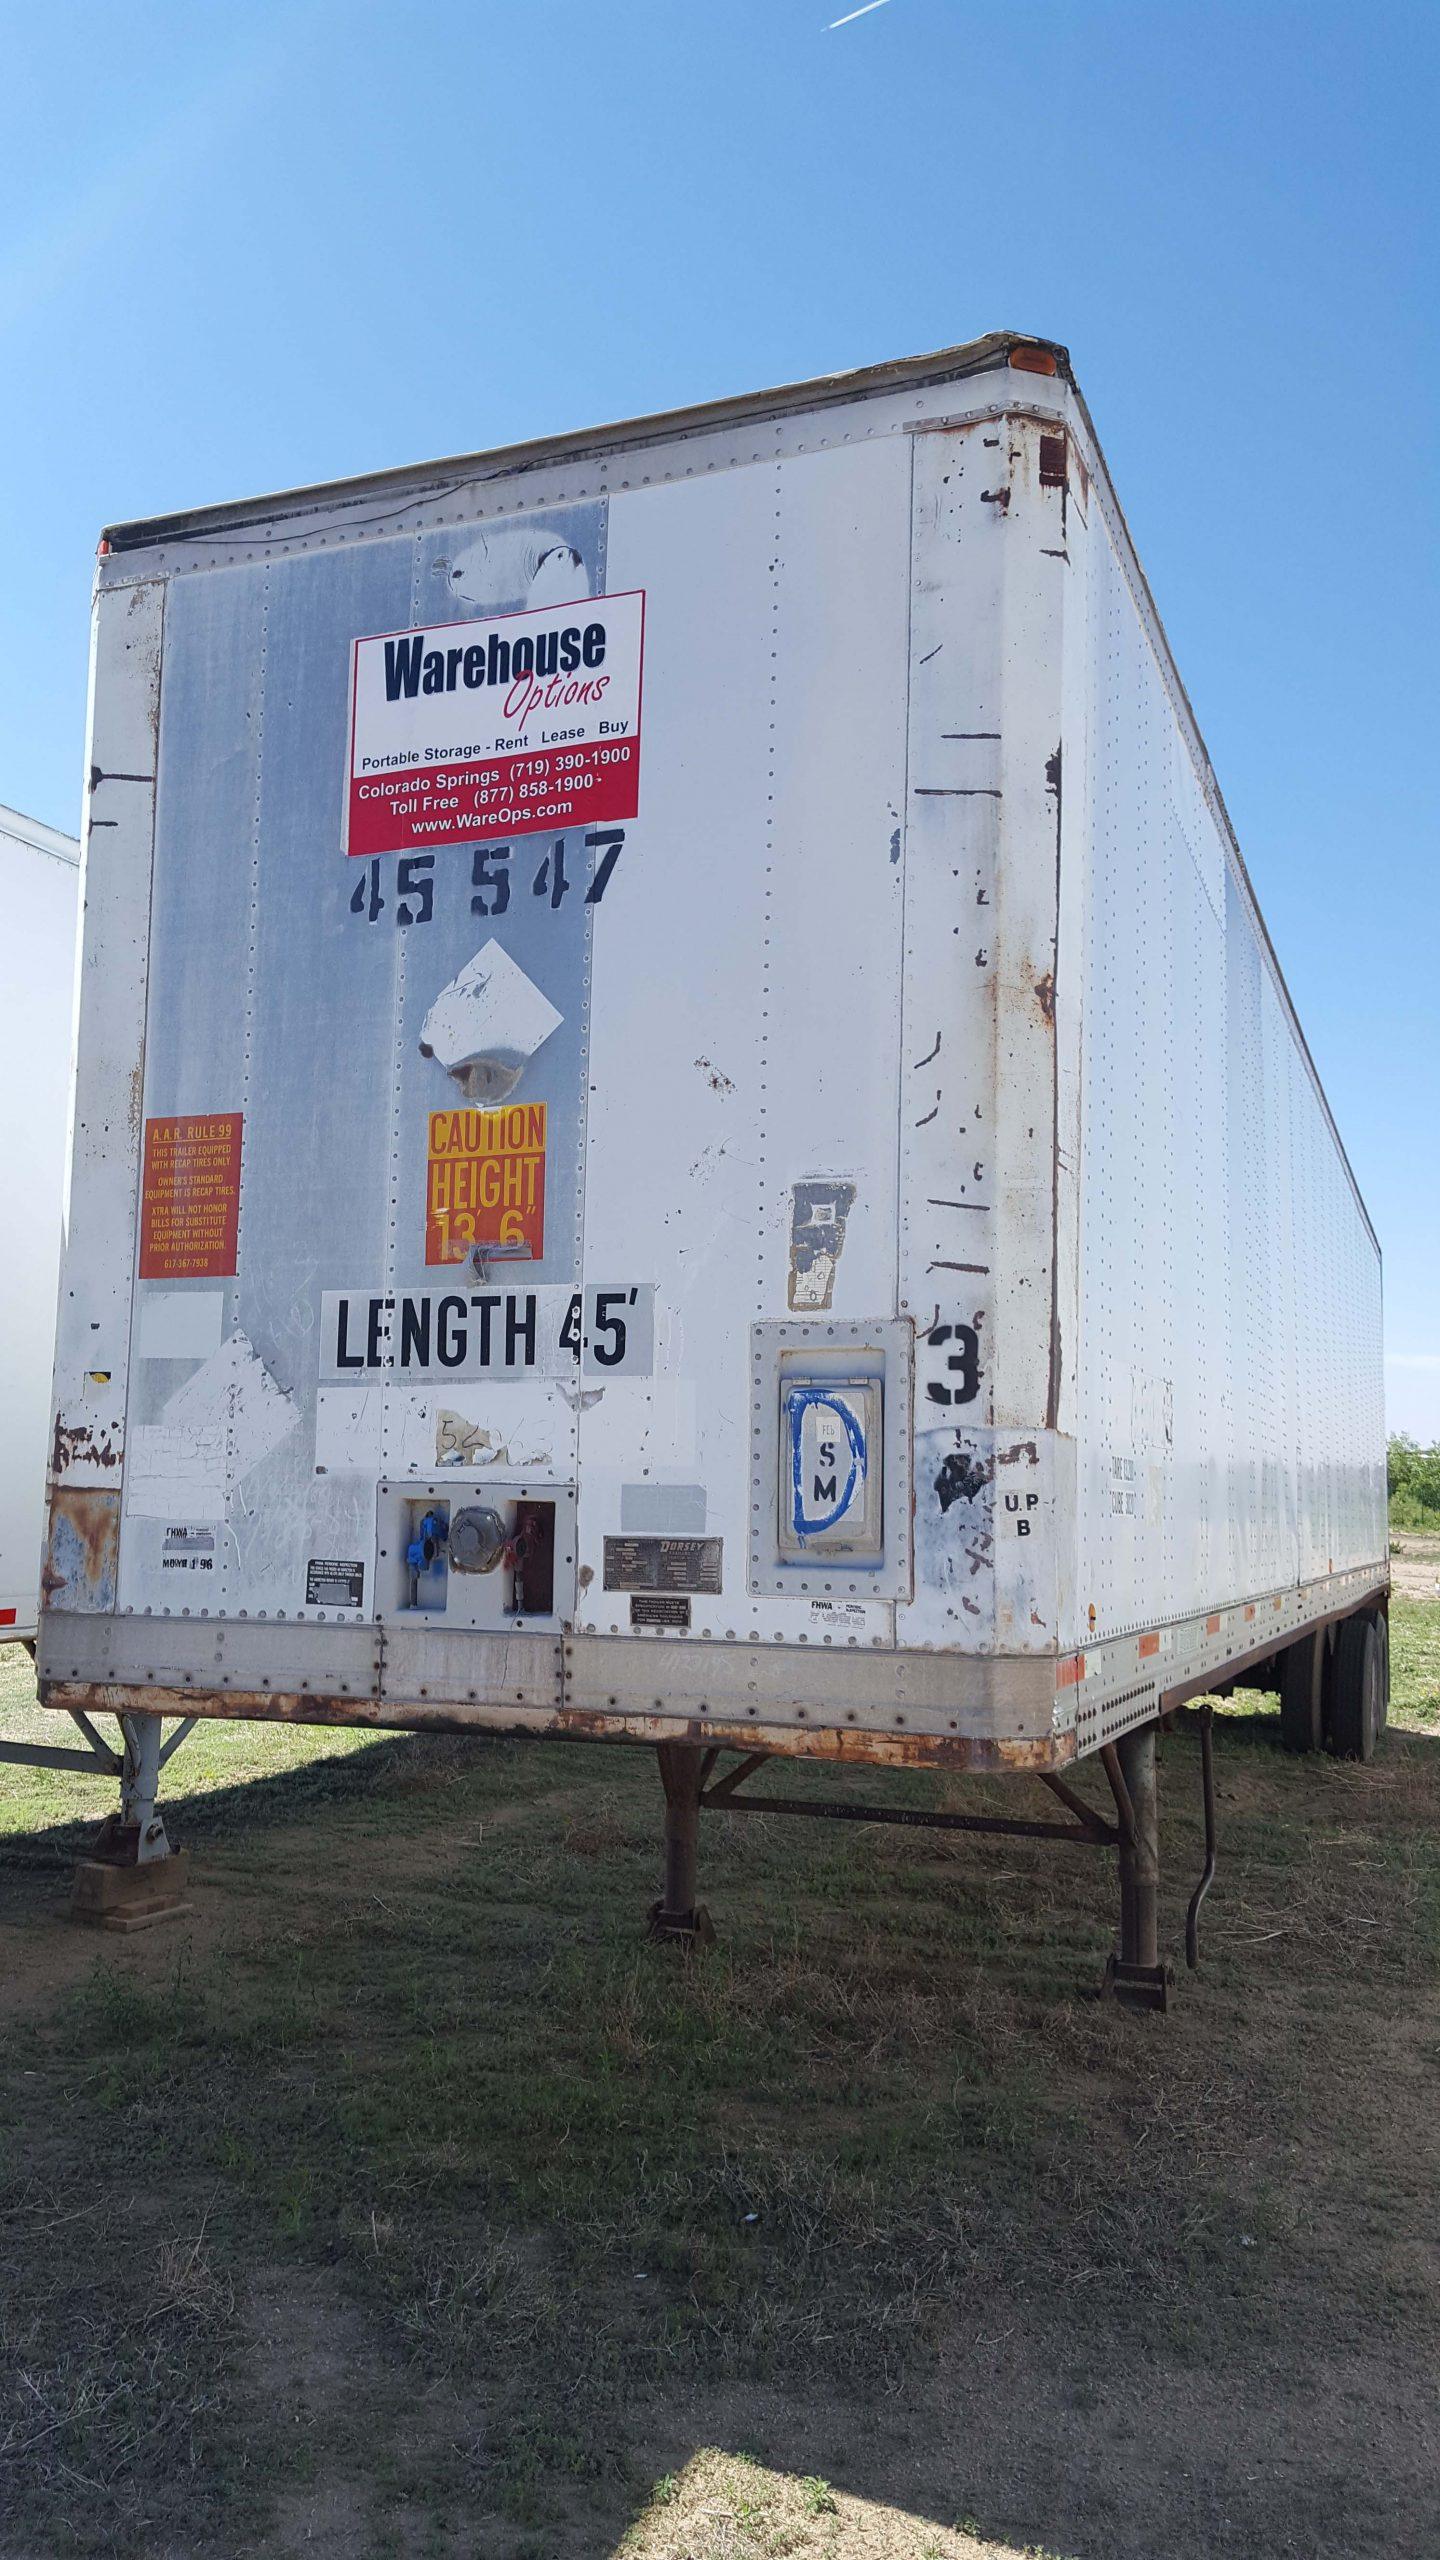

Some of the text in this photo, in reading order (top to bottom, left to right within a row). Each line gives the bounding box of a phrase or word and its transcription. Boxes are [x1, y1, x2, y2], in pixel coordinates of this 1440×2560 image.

[384, 622, 606, 702] Warehouse
[502, 669, 611, 732] Options
[362, 751, 420, 770] Portable
[424, 743, 481, 762] Storage
[495, 735, 529, 751] Rent
[541, 726, 585, 744] Lease
[599, 719, 629, 735] Buy
[359, 746, 631, 800] Colorado Springs (719) 390-1900
[389, 773, 594, 816] Toll Free (877) 858-1900
[411, 800, 573, 834] www.WareOps.com
[187, 1125, 215, 1139] RULE
[218, 1124, 232, 1137] 99
[430, 1104, 545, 1155] CAUTION
[152, 1145, 231, 1157] THIS TRAILER EQUIPPED
[151, 1160, 169, 1170] WITH
[170, 1159, 190, 1169] RECAP
[192, 1158, 211, 1167] TIRES
[158, 1174, 224, 1186] OWNER'S STANDARD
[431, 1157, 541, 1211] HEIGHT
[145, 1188, 182, 1200] EQUIPMENT
[184, 1188, 191, 1198] IS
[191, 1187, 213, 1197] RECAP
[151, 1203, 228, 1216] XTRA WILL NOT HONOR
[151, 1216, 227, 1228] BILLS FOR SUBSTITUTE
[153, 1228, 223, 1241] EQUIPMENT WITHOUT
[149, 1242, 169, 1252] PRIOR
[336, 1294, 537, 1368] LENGTH
[926, 1324, 981, 1405] 3
[819, 1442, 836, 1467] S
[814, 1474, 837, 1502] M
[1016, 1519, 1031, 1537] B
[660, 1541, 705, 1553] DORSEY
[811, 1601, 833, 1610] FHWA
